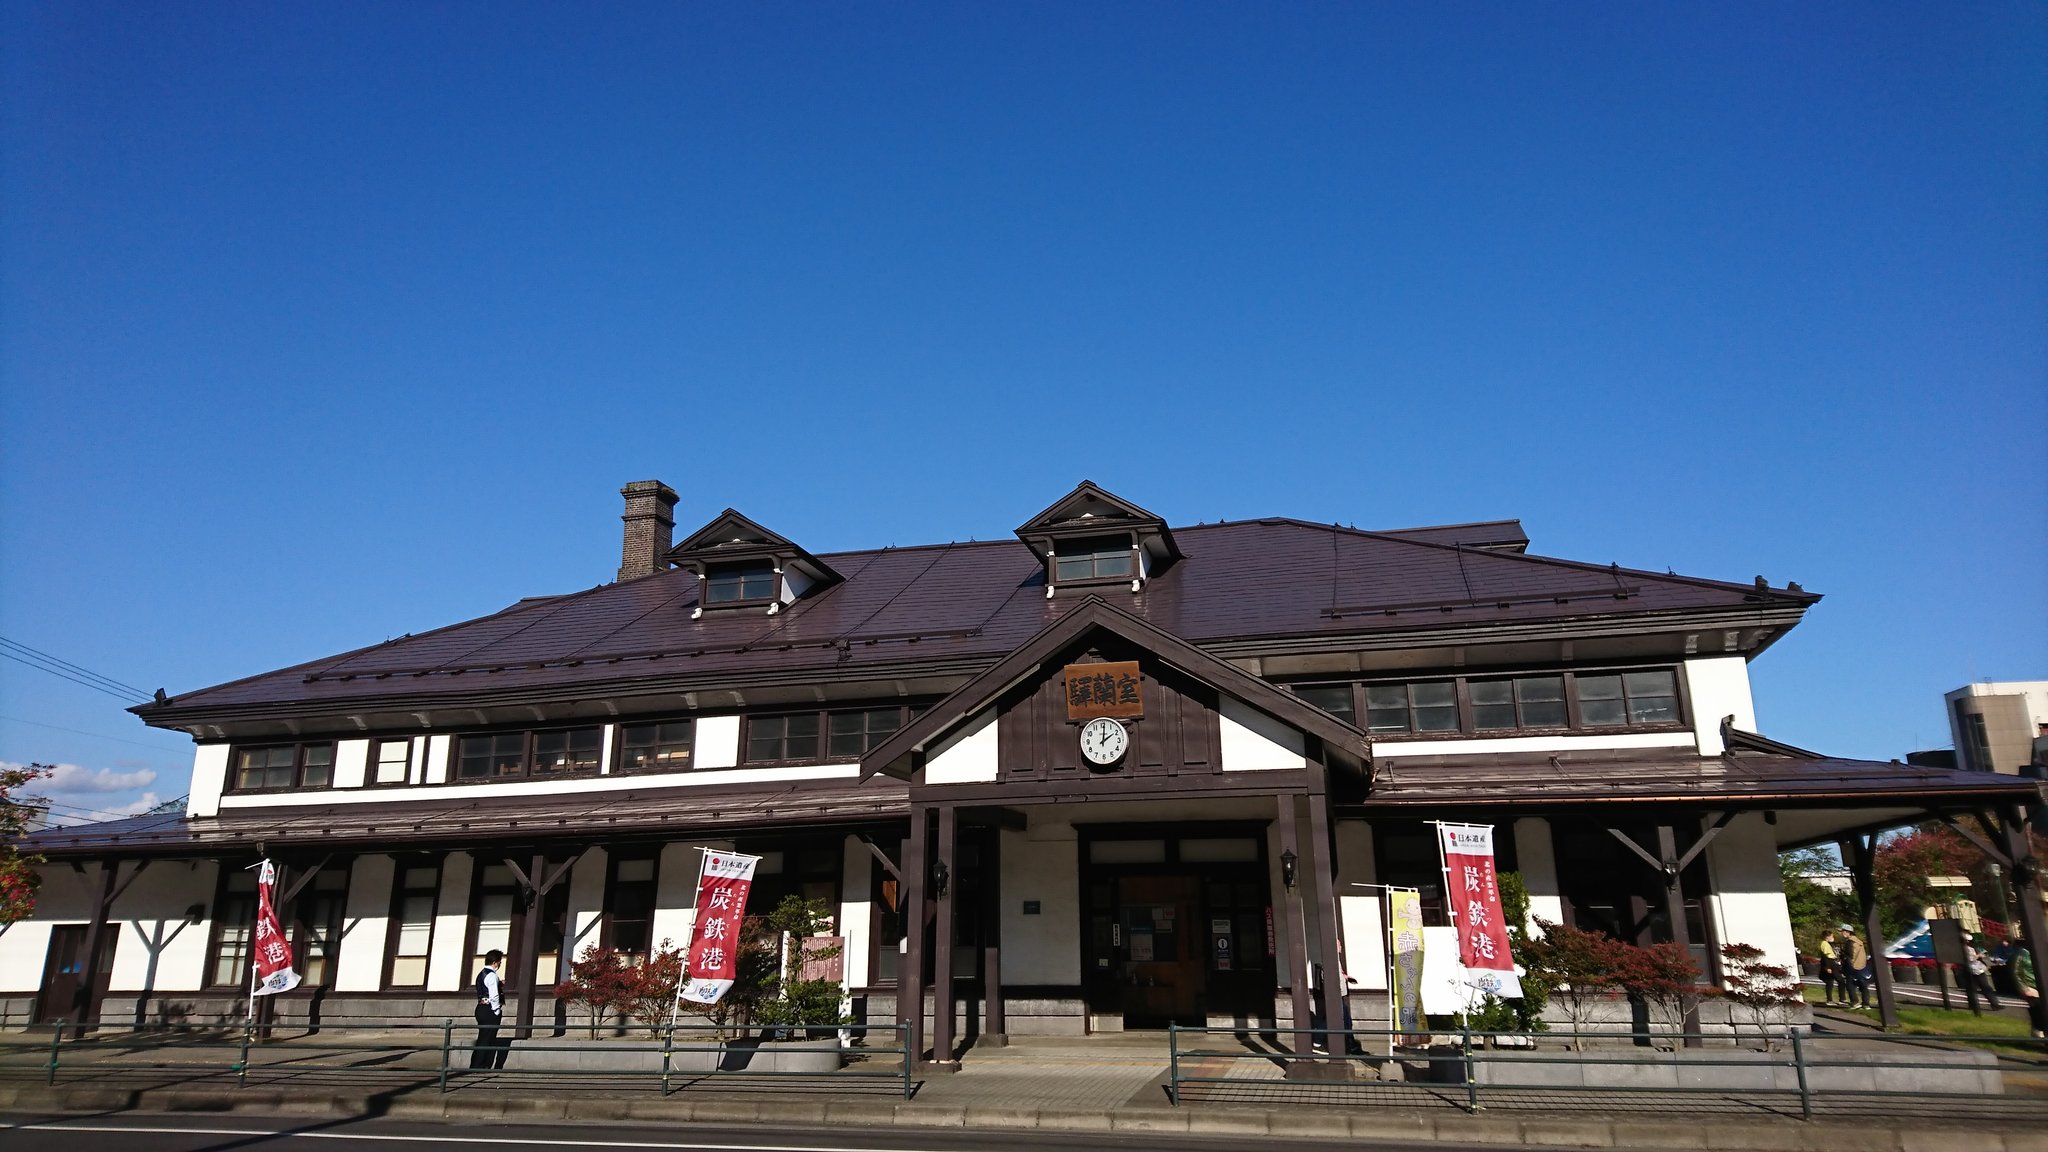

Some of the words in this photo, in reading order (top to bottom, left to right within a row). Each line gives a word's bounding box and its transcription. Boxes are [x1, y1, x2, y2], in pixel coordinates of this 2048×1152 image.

[721, 860, 750, 870] 日本遺産
[1458, 834, 1486, 843] 日本遺産
[1464, 865, 1495, 960] 炭鉄港
[1484, 861, 1496, 902] 北の産業革命
[257, 893, 285, 965] 鉄港
[701, 887, 732, 970] 炭鉄港
[1398, 931, 1418, 1025] 赤ちゃんの駅
